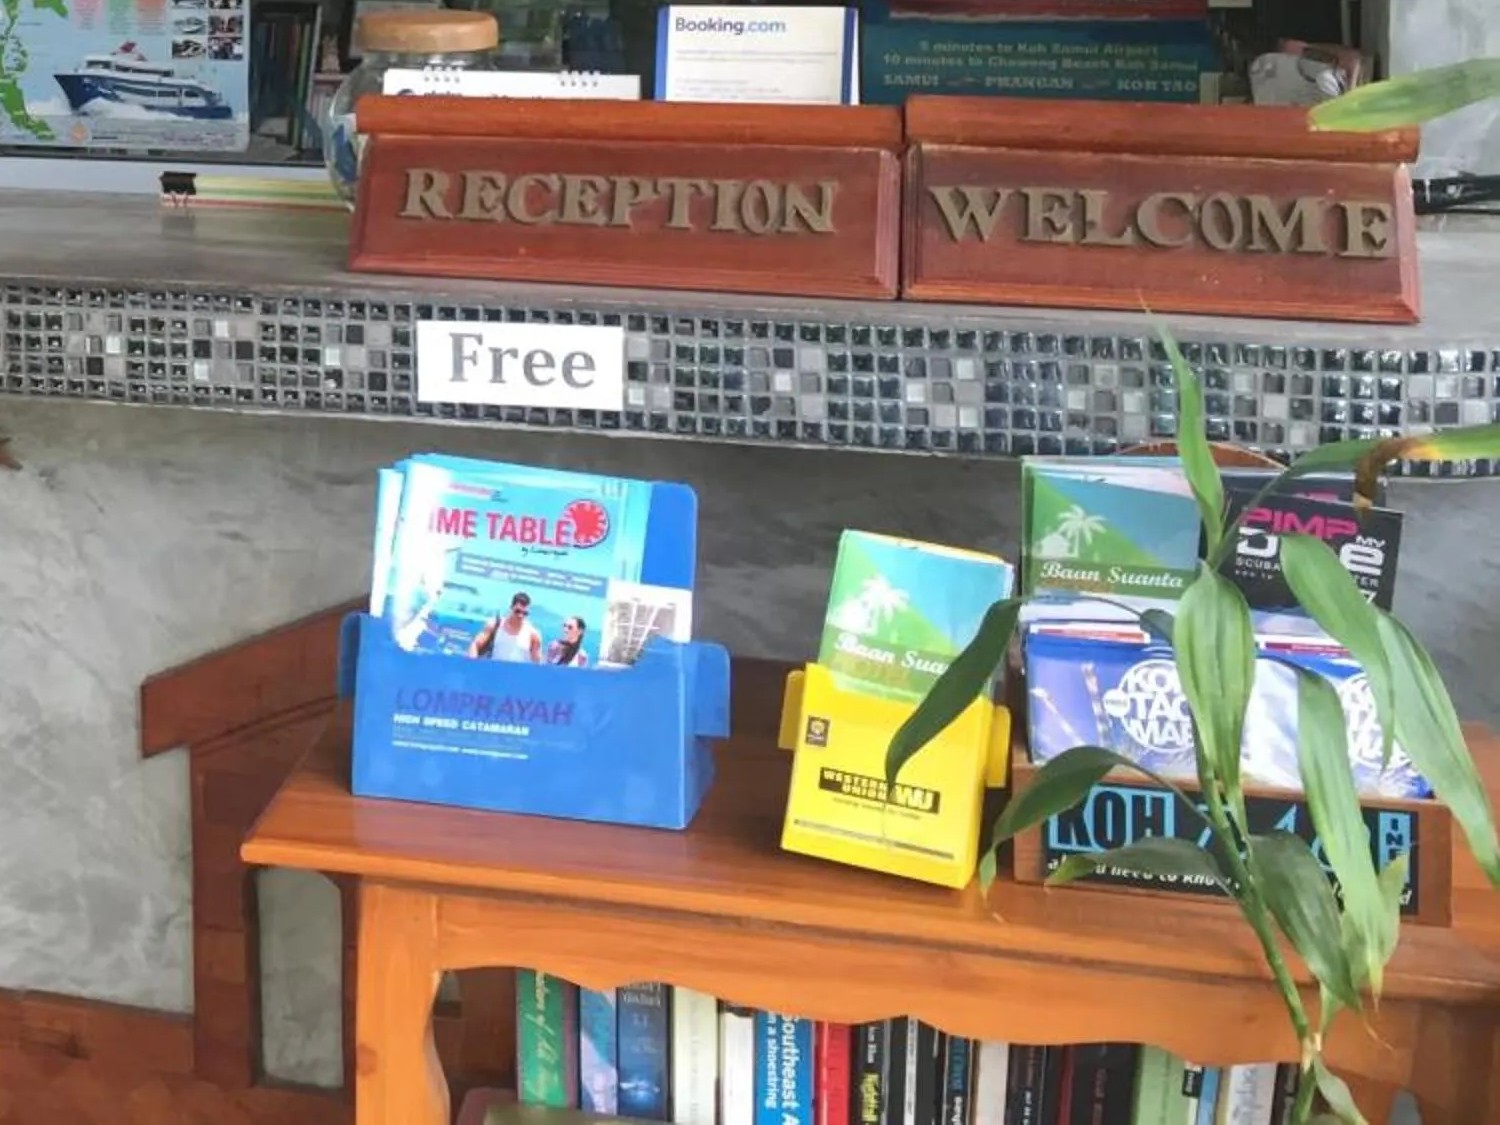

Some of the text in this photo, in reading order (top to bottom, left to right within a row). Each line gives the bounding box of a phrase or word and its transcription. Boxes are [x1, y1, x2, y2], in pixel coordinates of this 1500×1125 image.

[675, 16, 786, 36] Booking.com
[399, 169, 838, 235] RECEPTION
[928, 184, 1393, 259] WELCOME
[449, 331, 597, 388] Free
[486, 511, 572, 548] TABLE
[1241, 507, 1358, 538] PIMP
[1040, 562, 1101, 583] Baan
[1235, 557, 1281, 572] SCUBA
[834, 632, 894, 665] Baan
[395, 686, 575, 725] LOMPRAYAH
[823, 770, 887, 792] WESTERN
[842, 785, 886, 800] UNION
[765, 1038, 779, 1109] shoestring
